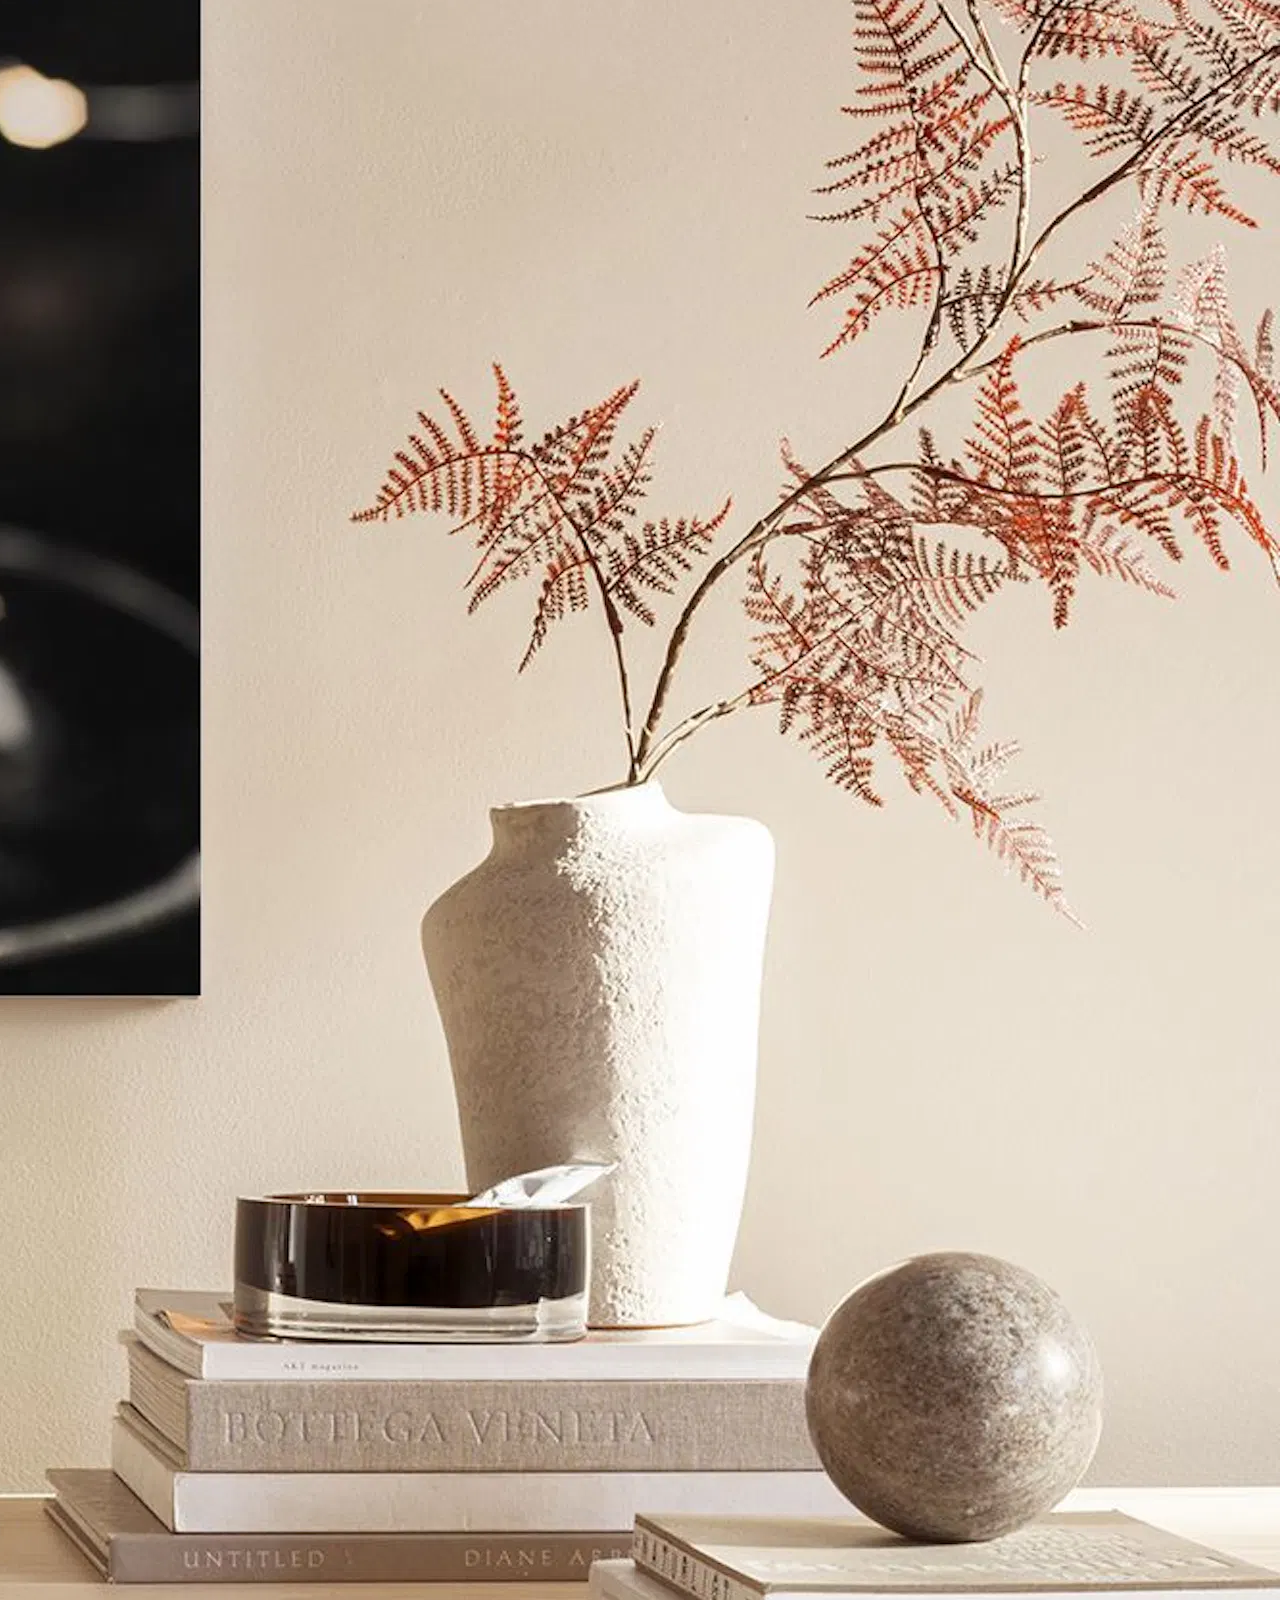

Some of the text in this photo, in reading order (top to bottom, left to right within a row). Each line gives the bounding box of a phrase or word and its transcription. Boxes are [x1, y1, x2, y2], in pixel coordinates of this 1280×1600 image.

[223, 1409, 656, 1445] BOTTEGA VENETA
[183, 1549, 325, 1569] UNTITLED
[464, 1549, 554, 1568] DIANE
